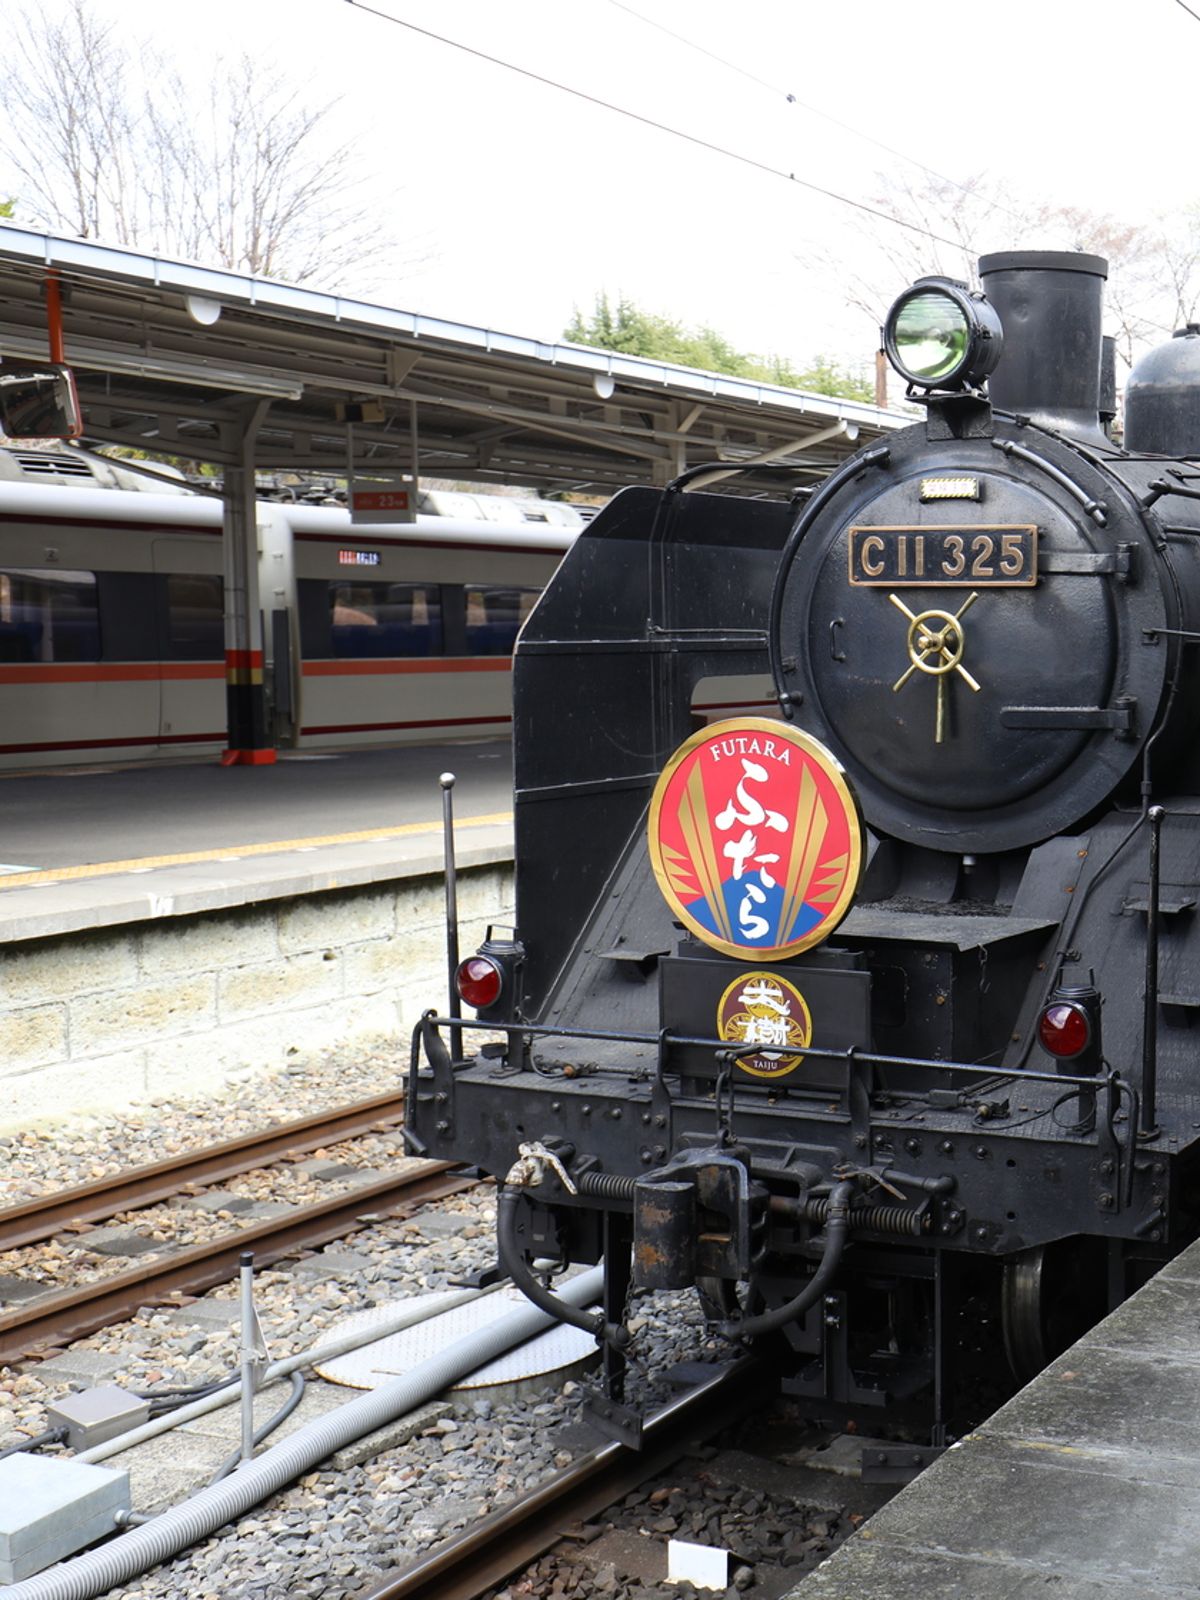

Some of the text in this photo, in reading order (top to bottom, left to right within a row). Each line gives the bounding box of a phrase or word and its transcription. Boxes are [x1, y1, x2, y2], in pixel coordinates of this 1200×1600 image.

[860, 535, 1025, 577] C11 325
[709, 737, 792, 767] FUTARA
[714, 757, 790, 940] ふたら
[753, 1060, 778, 1070] TAIJU
